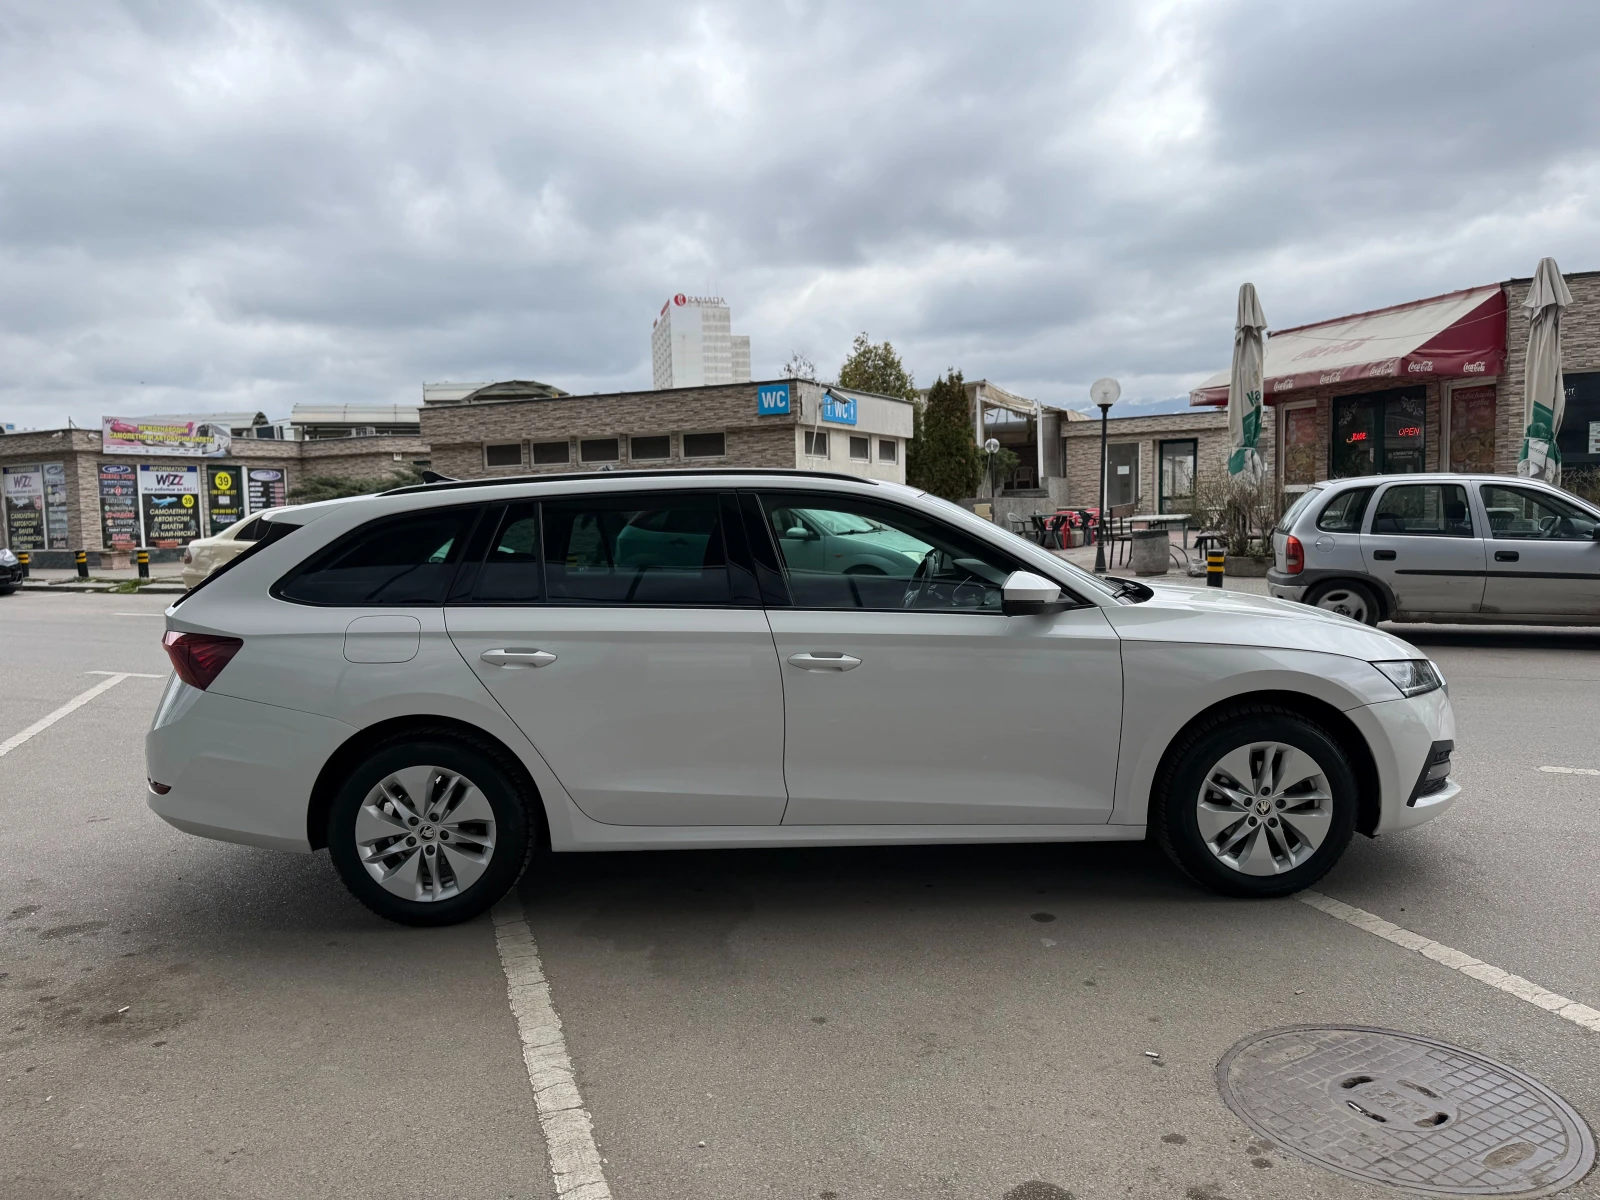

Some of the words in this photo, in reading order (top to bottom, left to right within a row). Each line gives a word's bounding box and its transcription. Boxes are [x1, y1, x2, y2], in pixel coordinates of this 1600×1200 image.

[687, 296, 726, 305] RAMADA
[1370, 362, 1394, 376] Coca-Cola
[1408, 361, 1433, 373] Coca-Cola
[1463, 361, 1486, 373] Coca-Cola
[1320, 371, 1340, 385] Coca-Cola
[1273, 379, 1293, 392] Coca-Cola
[761, 390, 786, 408] WC
[834, 401, 847, 418] WC
[138, 424, 189, 433] МЕЖДУНАРОДНИ
[1398, 427, 1420, 436] OPEN
[109, 432, 148, 441] САМОЛЕТНИ
[155, 435, 192, 443] АВТОБУСНИ
[217, 476, 229, 486] 39
[184, 496, 193, 505] 39
